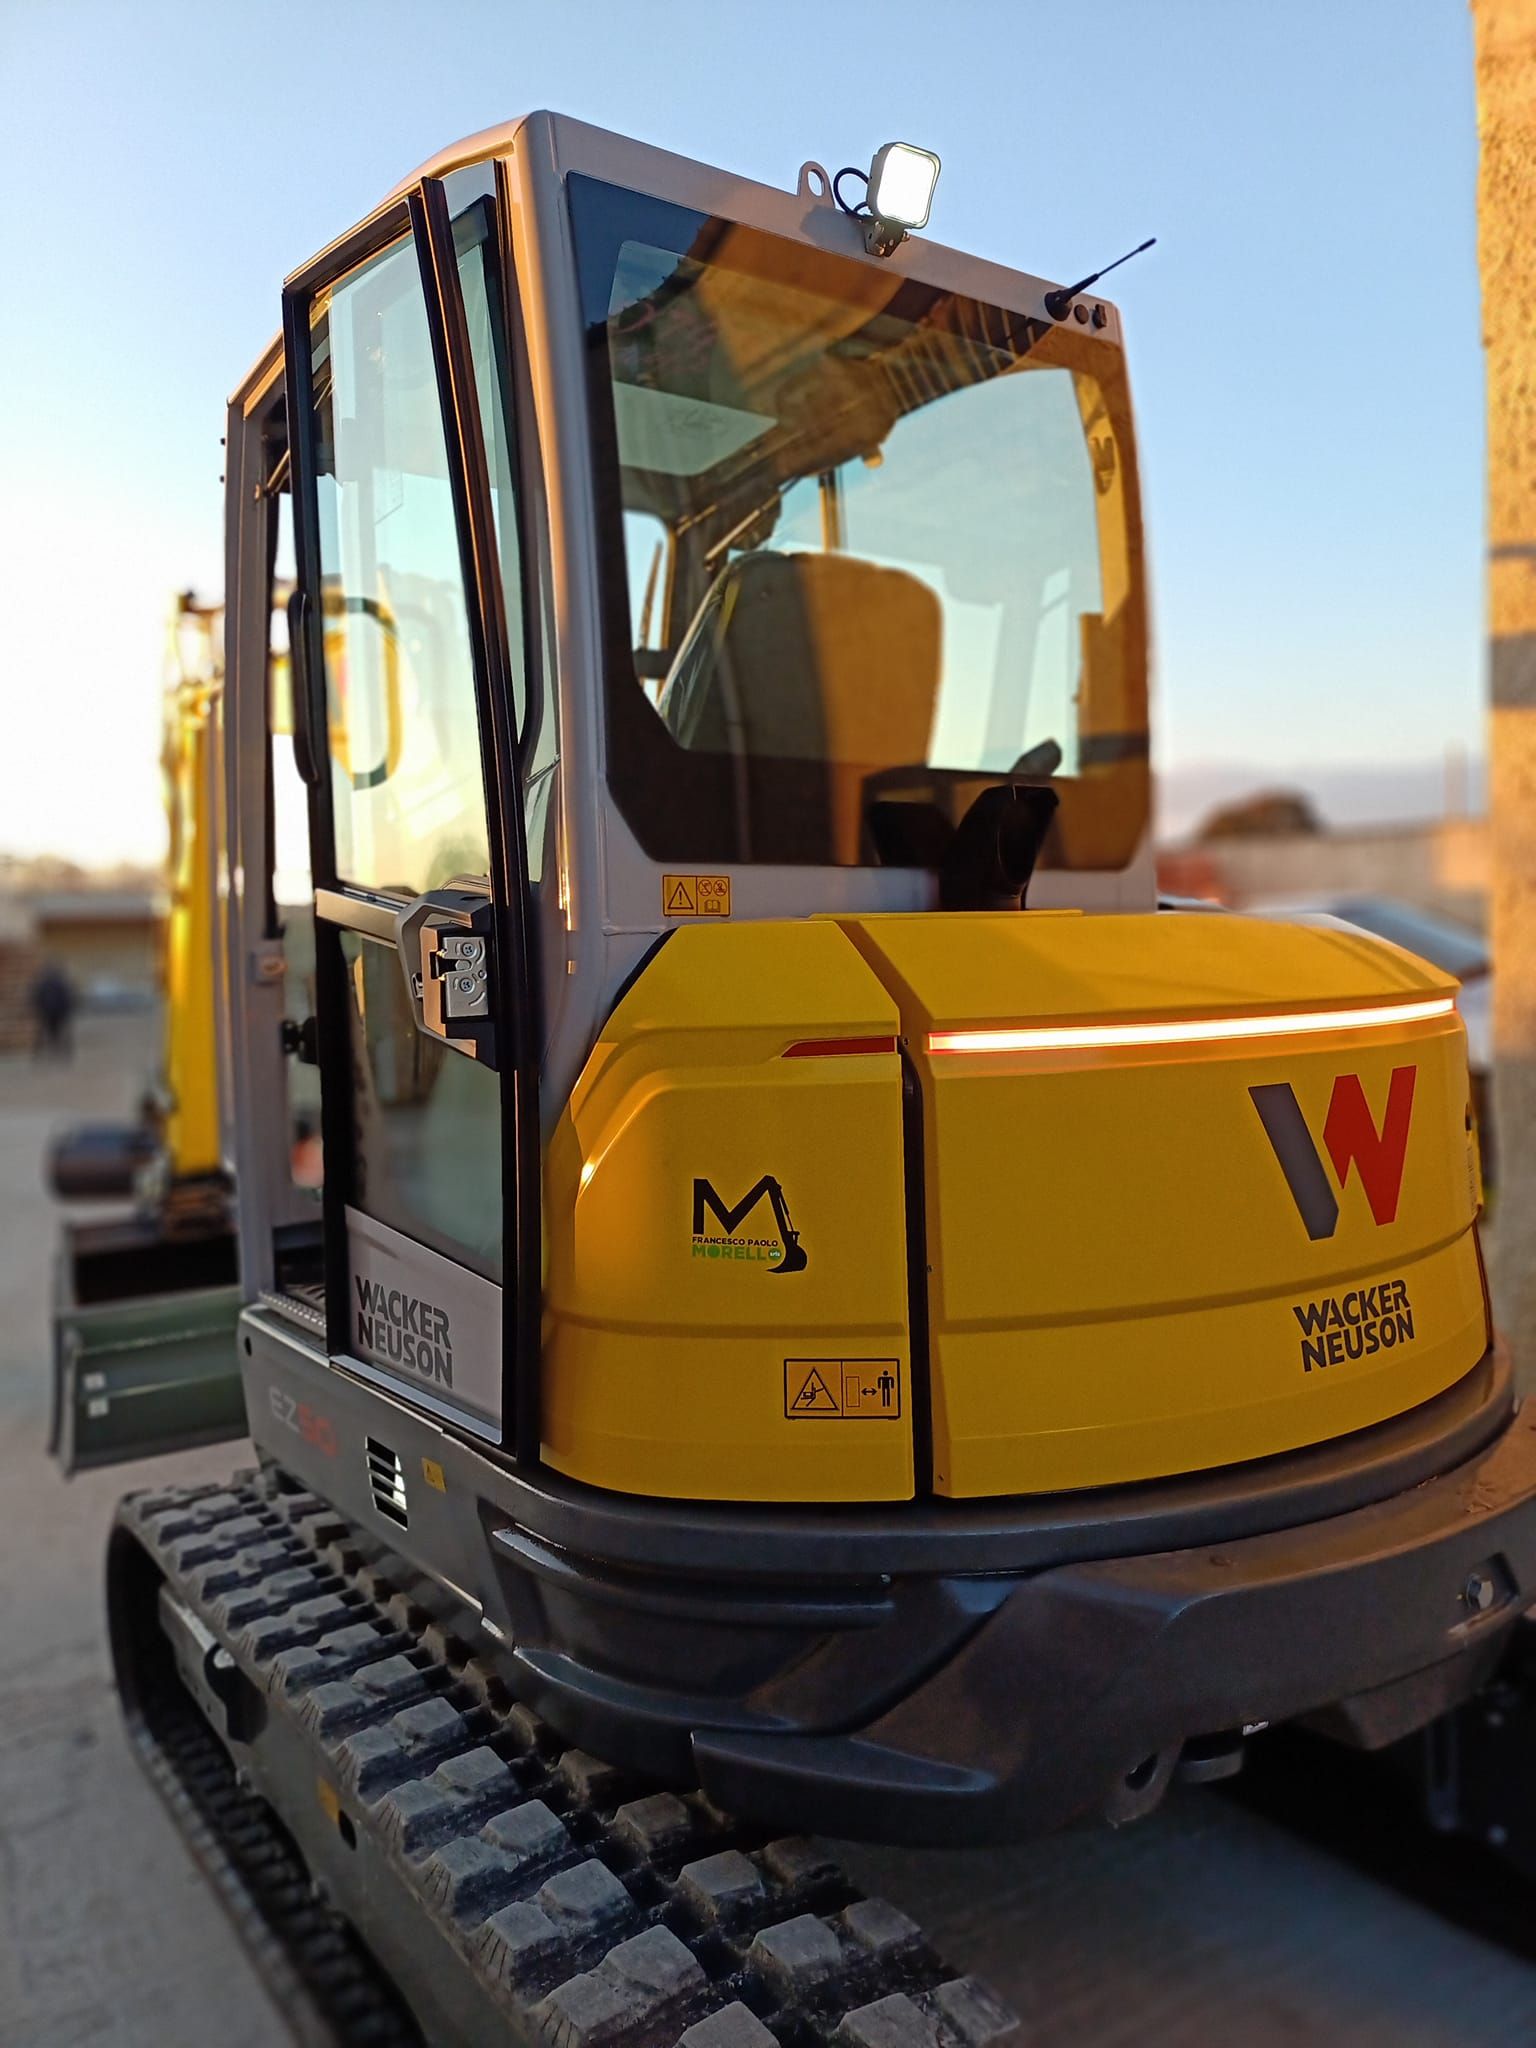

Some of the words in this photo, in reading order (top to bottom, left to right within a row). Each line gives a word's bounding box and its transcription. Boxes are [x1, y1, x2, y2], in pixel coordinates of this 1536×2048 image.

[692, 1236, 746, 1246] FRANCESCO
[747, 1239, 778, 1247] PAOLO
[355, 1275, 452, 1350] WACKER
[1293, 1279, 1410, 1336] WACKER
[358, 1312, 453, 1389] NEUSON
[1301, 1309, 1415, 1372] NEUSON
